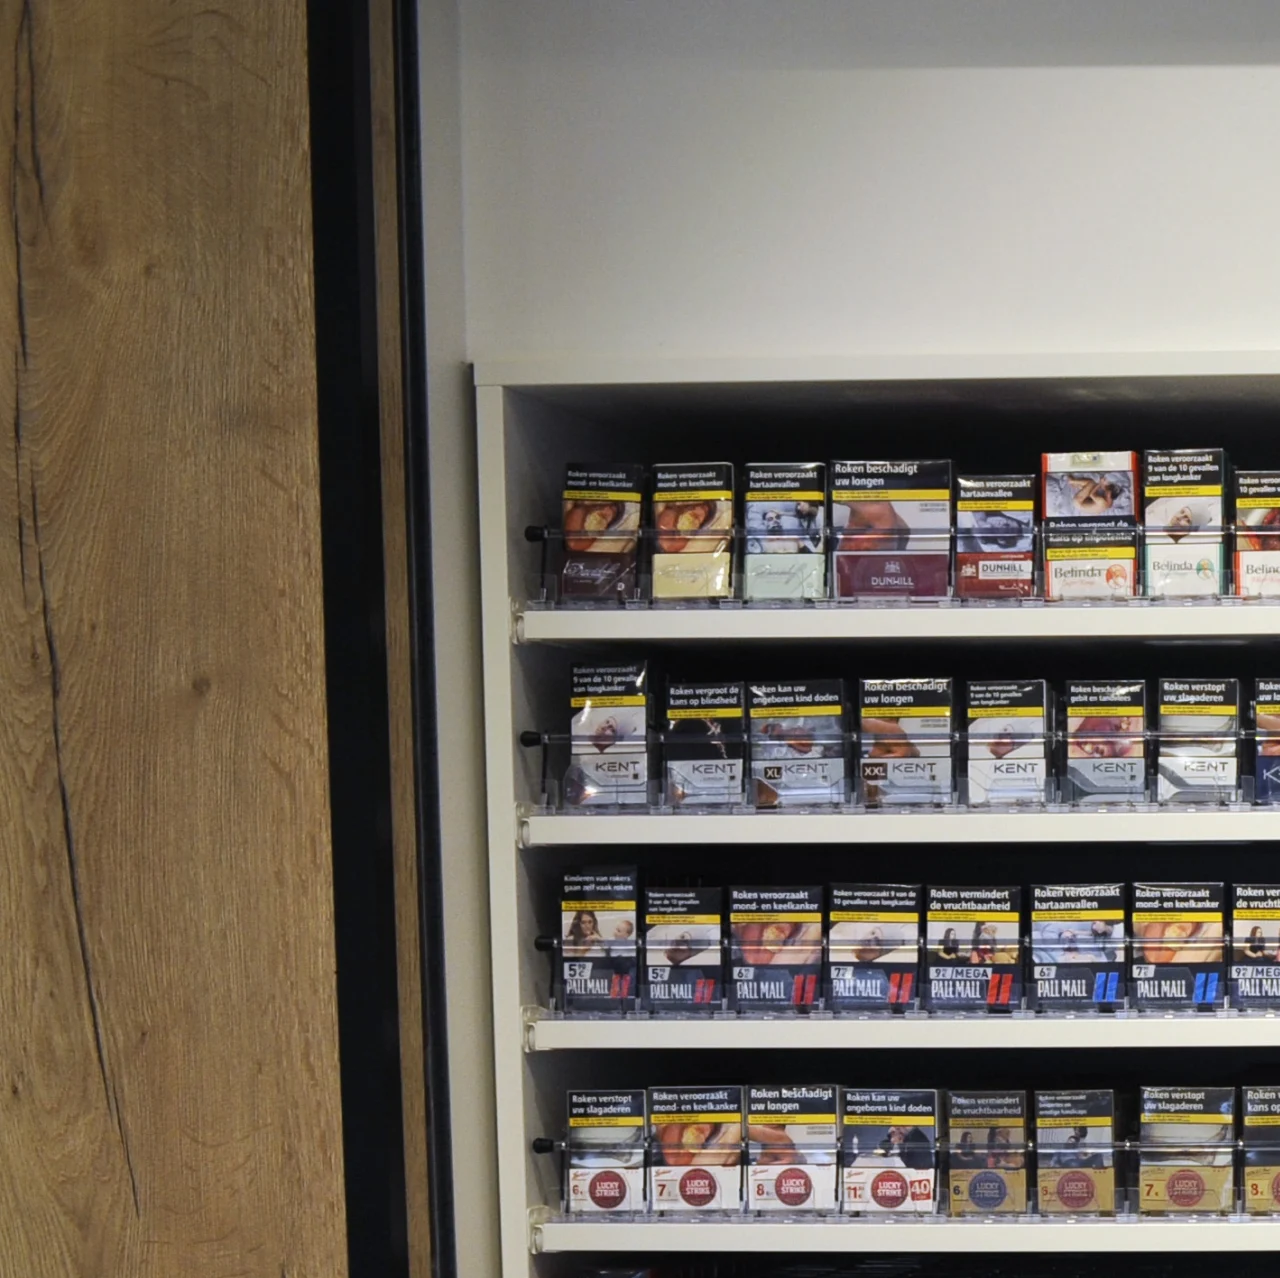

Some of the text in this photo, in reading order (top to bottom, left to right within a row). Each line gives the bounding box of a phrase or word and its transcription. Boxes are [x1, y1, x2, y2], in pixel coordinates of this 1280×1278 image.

[834, 462, 918, 475] Roken beschadigt
[850, 475, 885, 488] longen
[1053, 564, 1101, 580] Belinda
[871, 576, 914, 586] DUNHILL
[784, 762, 829, 774] KENT
[863, 765, 886, 777] XXL
[1092, 761, 1138, 773] KENT
[953, 967, 989, 978] MEGA
[687, 1179, 710, 1189] LUCKY
[911, 1180, 930, 1194] 40
